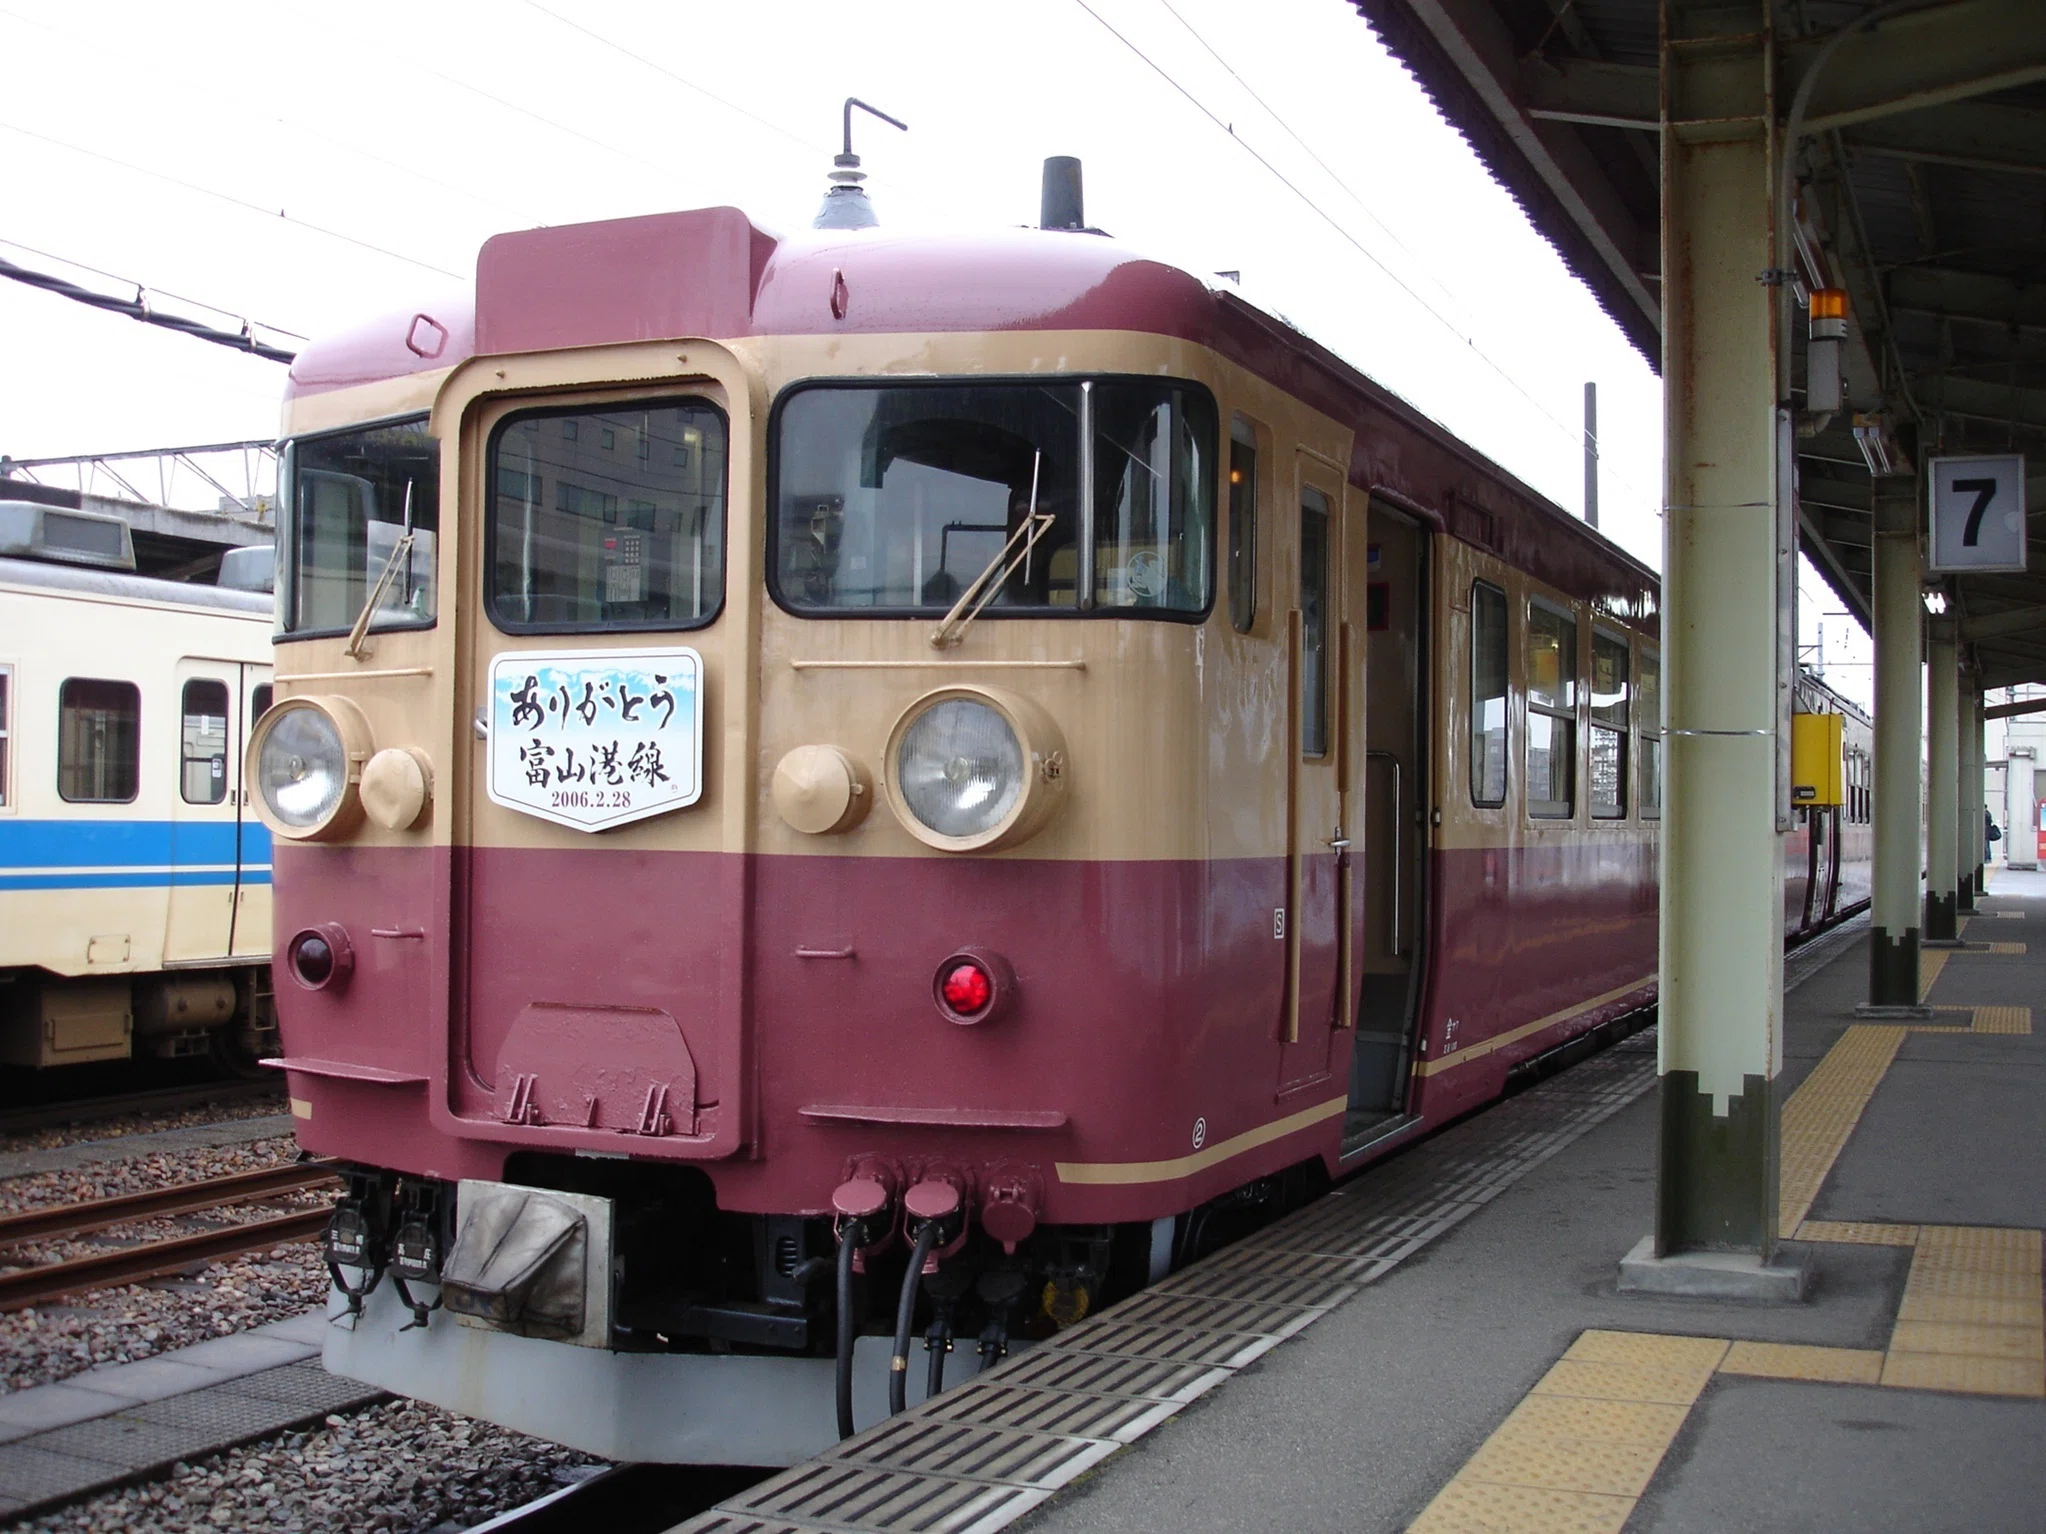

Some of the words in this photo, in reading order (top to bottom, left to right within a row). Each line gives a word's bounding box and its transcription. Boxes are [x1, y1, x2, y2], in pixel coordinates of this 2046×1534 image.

[1952, 478, 1996, 547] 7
[510, 674, 675, 731] ありがとう
[520, 738, 671, 788] 富山港線
[551, 791, 631, 808] 2006.2.28
